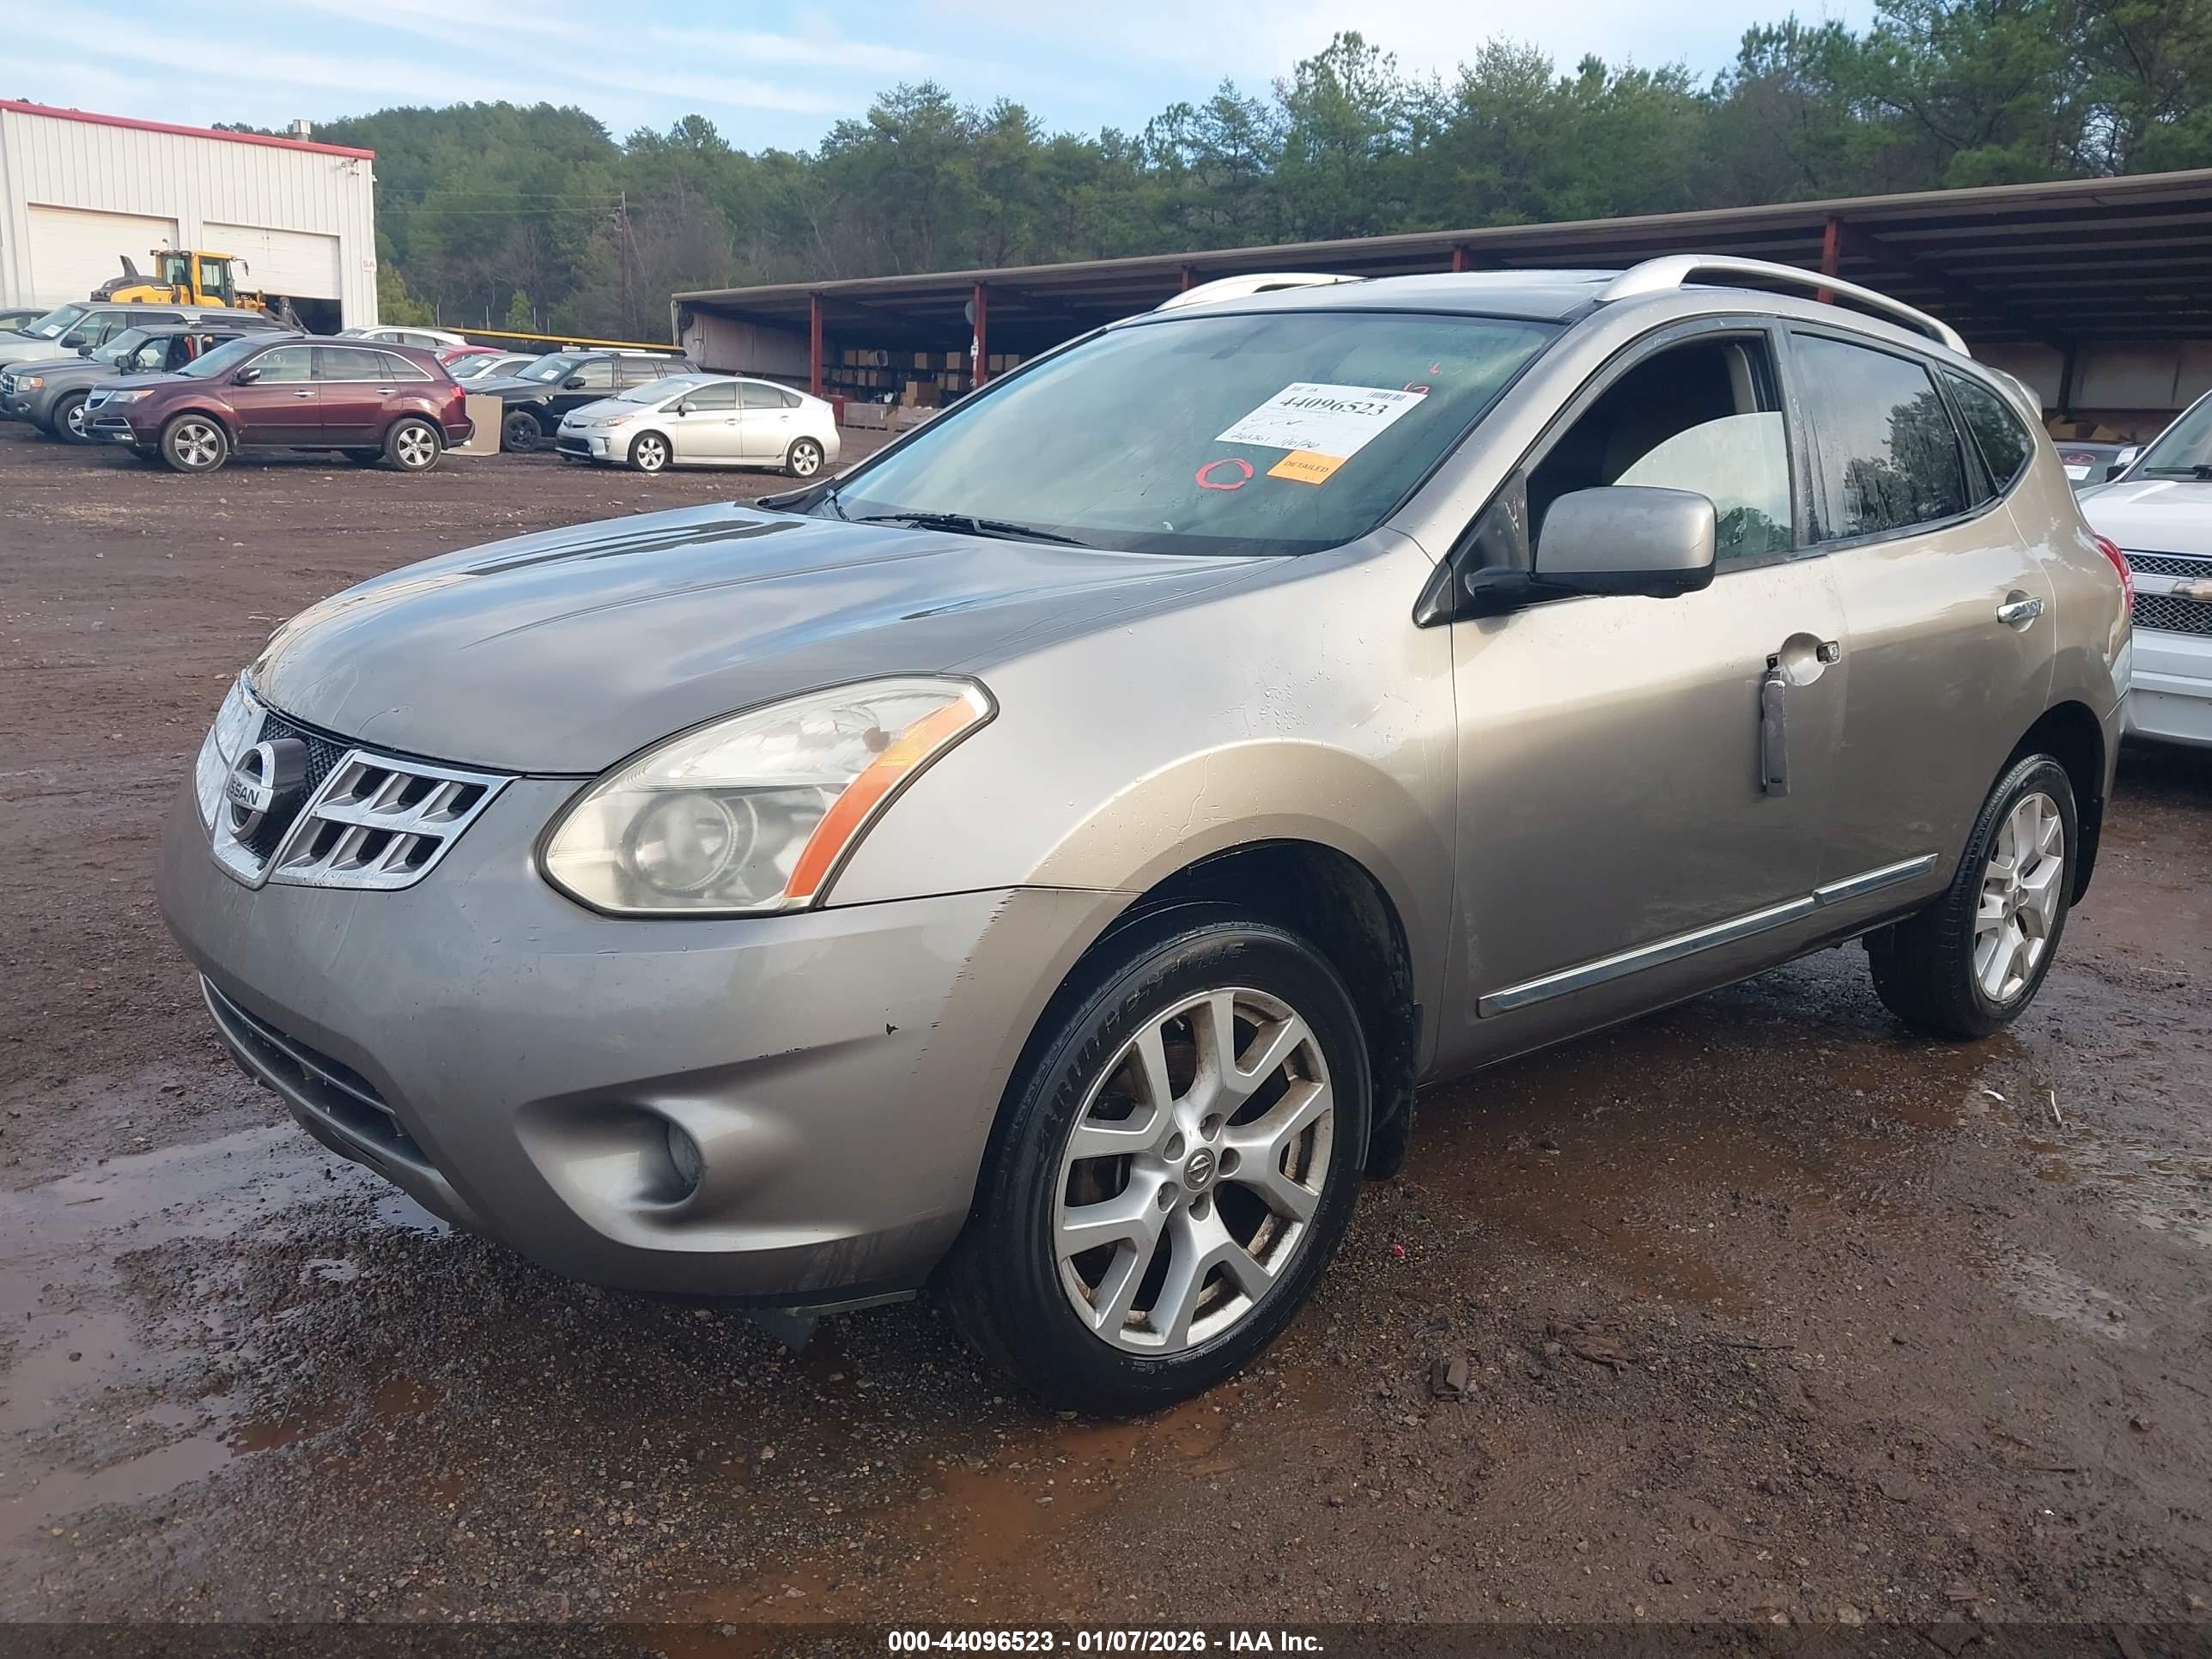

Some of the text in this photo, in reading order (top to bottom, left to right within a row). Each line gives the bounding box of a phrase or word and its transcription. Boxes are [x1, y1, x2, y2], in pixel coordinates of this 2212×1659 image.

[1279, 396, 1389, 416] 44096523
[1285, 460, 1329, 473] DETAILED
[229, 781, 260, 805] SSAN
